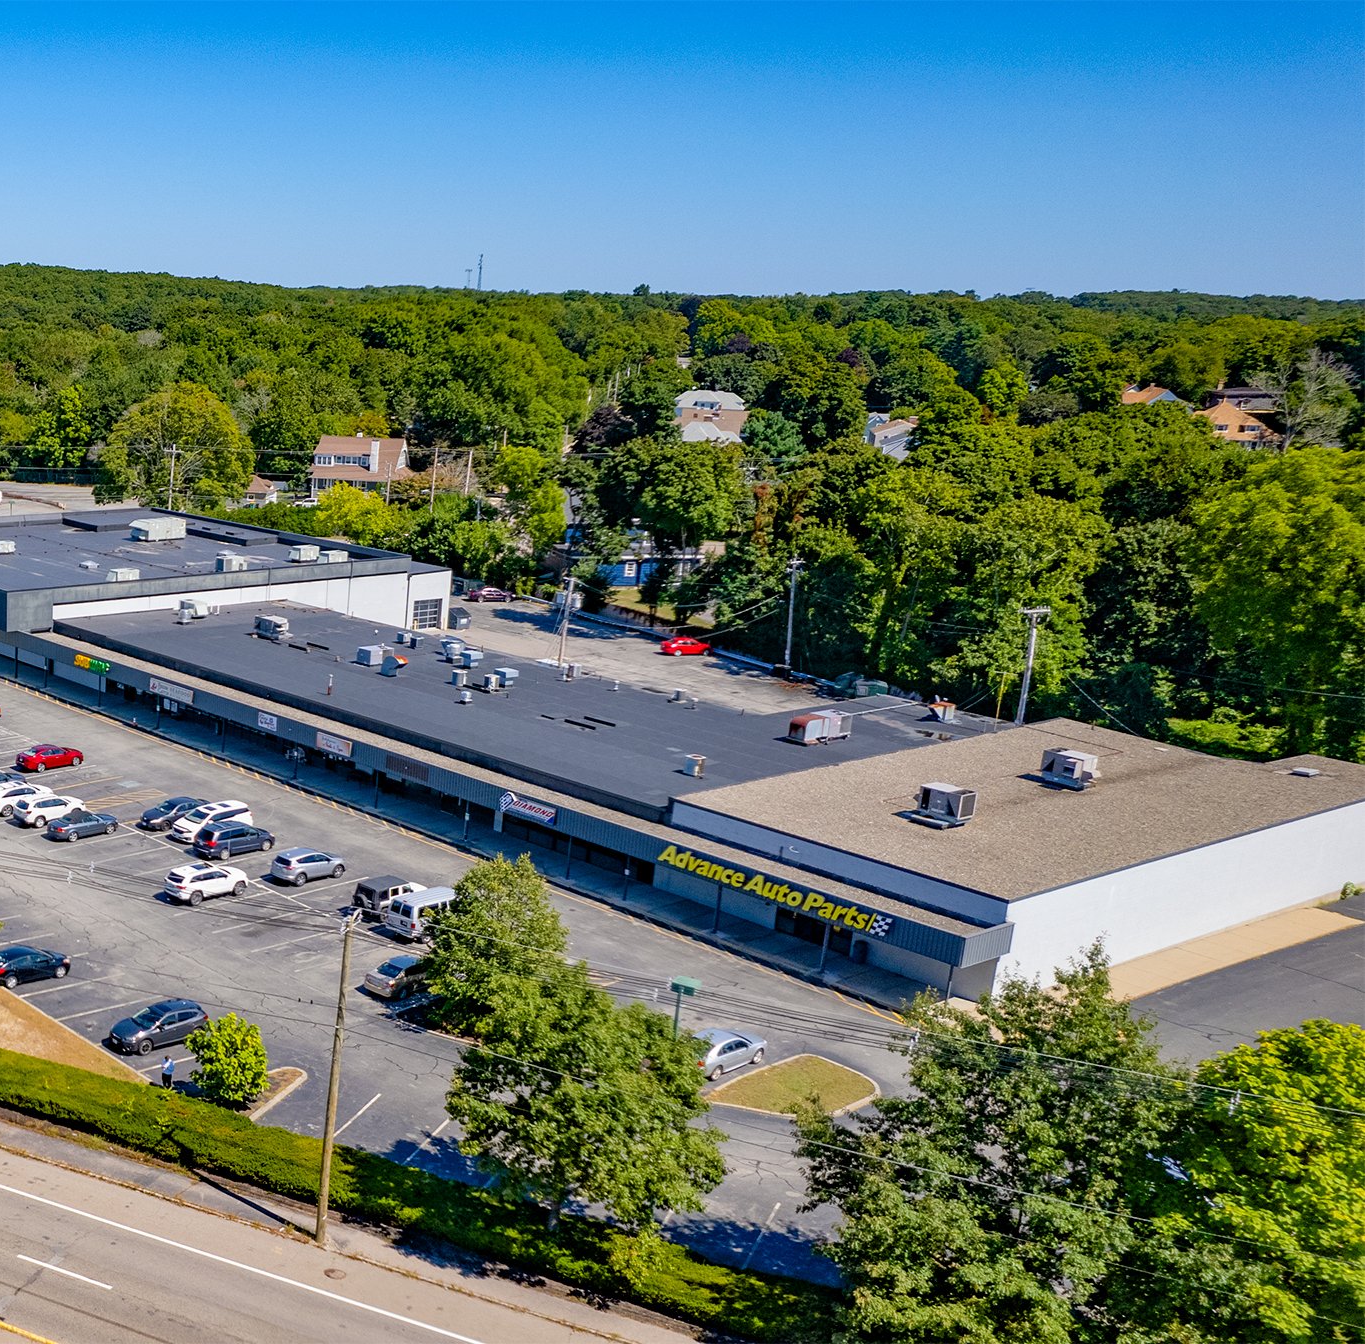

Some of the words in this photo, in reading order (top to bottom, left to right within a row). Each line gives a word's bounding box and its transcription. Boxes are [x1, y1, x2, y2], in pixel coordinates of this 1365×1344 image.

[74, 654, 110, 675] SUBWAY
[513, 800, 555, 818] DIAMOND
[657, 845, 746, 888] Advance
[743, 875, 804, 907] Auto
[801, 892, 870, 929] Parts
